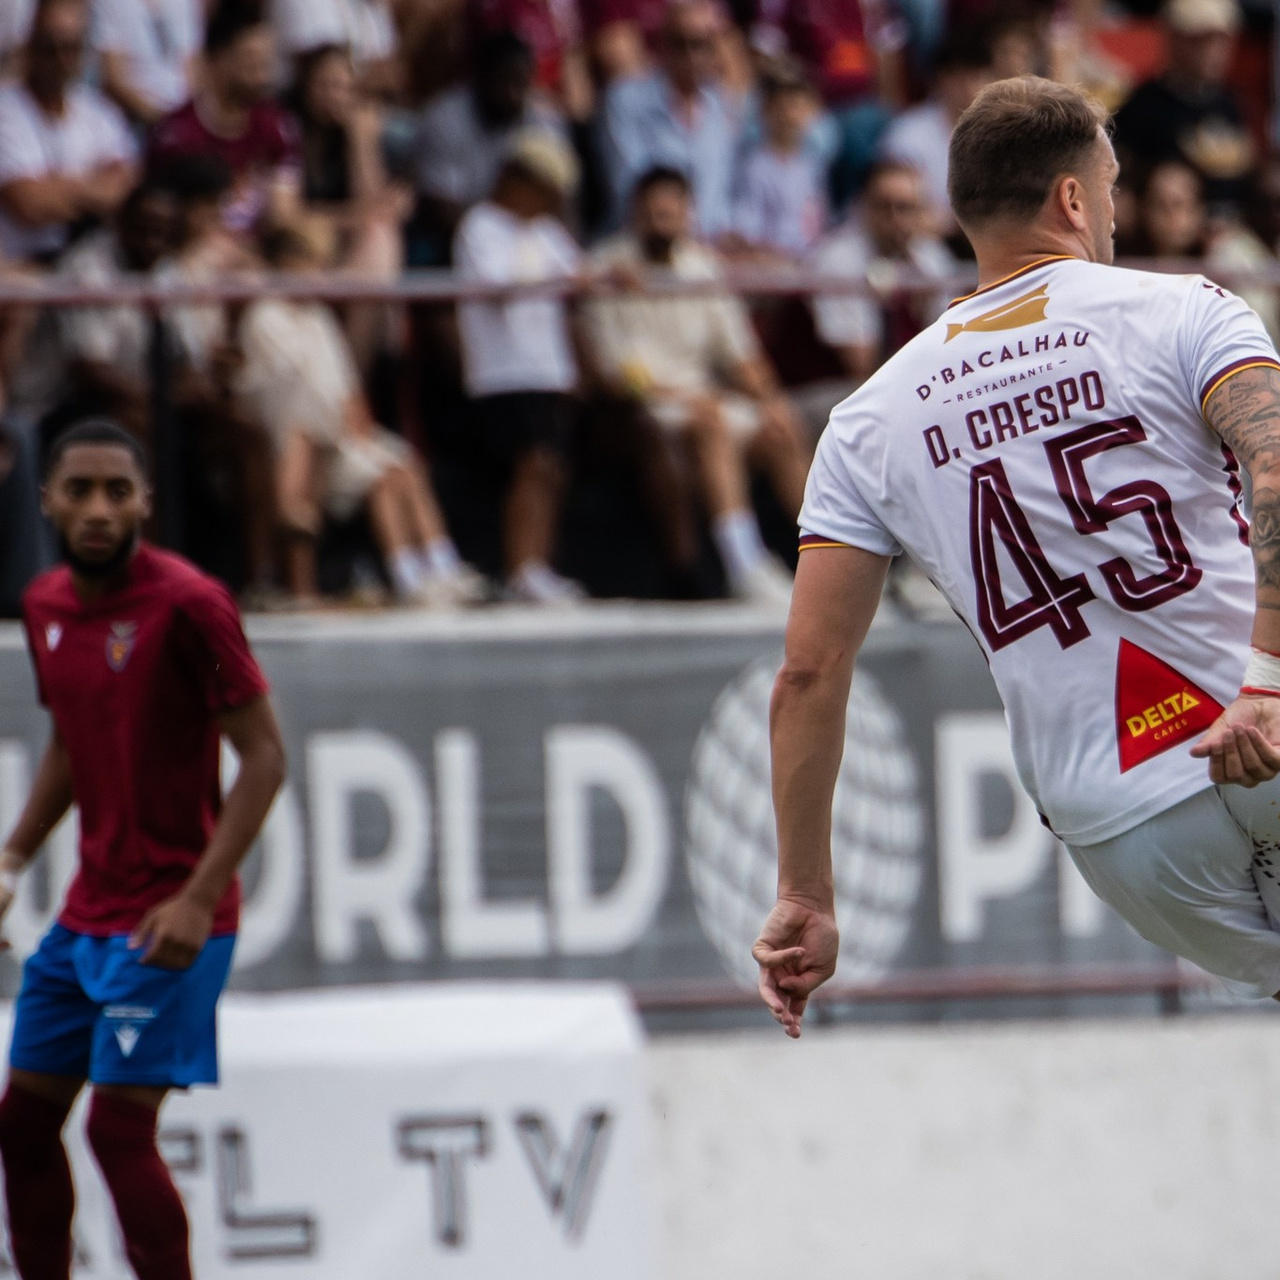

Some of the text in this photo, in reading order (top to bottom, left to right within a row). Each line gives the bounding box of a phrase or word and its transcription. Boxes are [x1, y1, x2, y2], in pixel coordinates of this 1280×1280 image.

[915, 331, 1090, 401] D'BACALHAU
[956, 362, 1054, 403] RESTAURANTE
[922, 370, 1106, 469] D. CRESPO
[968, 414, 1204, 653] 45
[1125, 691, 1200, 738] DELTA
[394, 1109, 611, 1249] TV
